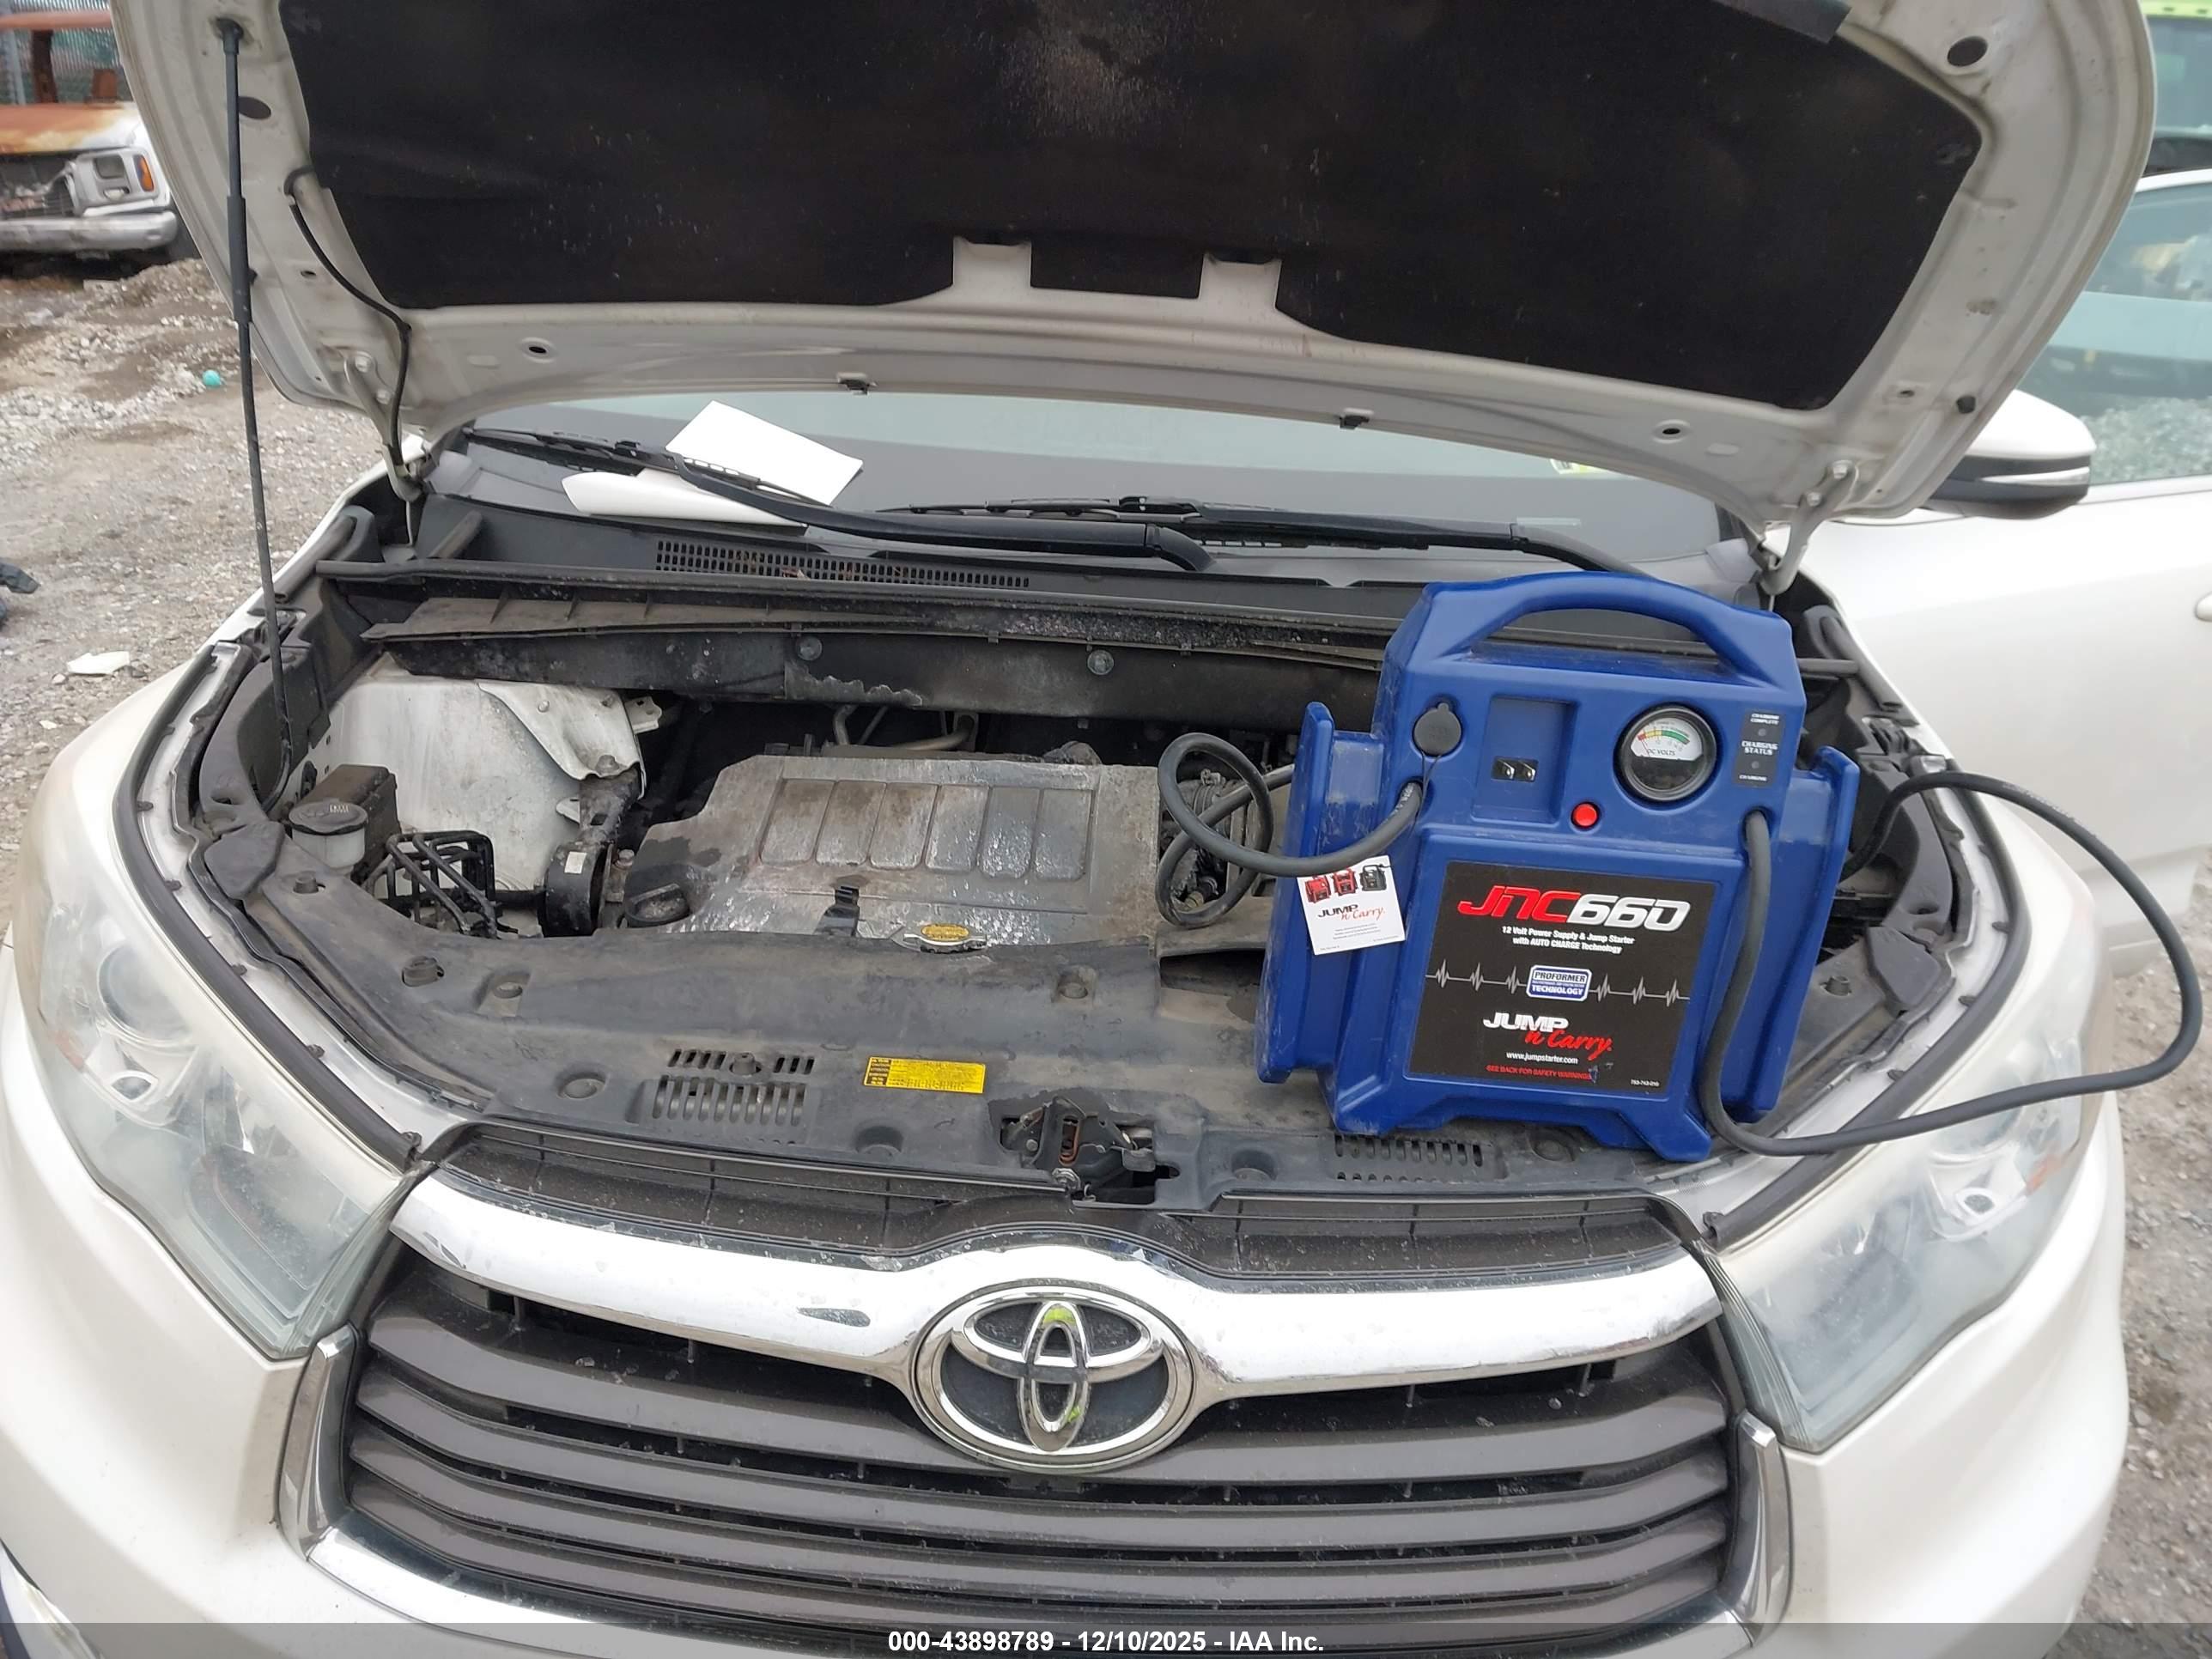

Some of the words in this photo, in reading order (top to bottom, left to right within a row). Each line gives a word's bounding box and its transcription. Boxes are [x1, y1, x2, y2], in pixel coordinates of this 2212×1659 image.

[1741, 740, 1778, 750] CHARGING
[1744, 746, 1773, 756] STATUS
[1317, 904, 1358, 918] JUMP
[1502, 926, 1512, 934] 12
[1513, 927, 1528, 936] Volt
[1528, 928, 1553, 938] Power
[1553, 930, 1578, 941] Supply
[1579, 932, 1586, 940] &
[1587, 933, 1607, 943] Jump
[1608, 934, 1635, 945] Starter
[1513, 937, 1529, 945] with
[1530, 938, 1550, 947] AUTO
[1551, 939, 1581, 950] CHARGE
[1581, 942, 1623, 954] Technology
[1534, 971, 1586, 982] PROFORMER
[1531, 984, 1583, 995] TECHNOLOGY
[1482, 1012, 1569, 1033] JUMP
[1506, 1051, 1578, 1065] www.jumpstarter.com
[1500, 1066, 1518, 1074] BACK
[1518, 1066, 1533, 1075] FOR
[1533, 1067, 1558, 1077] SAFETY
